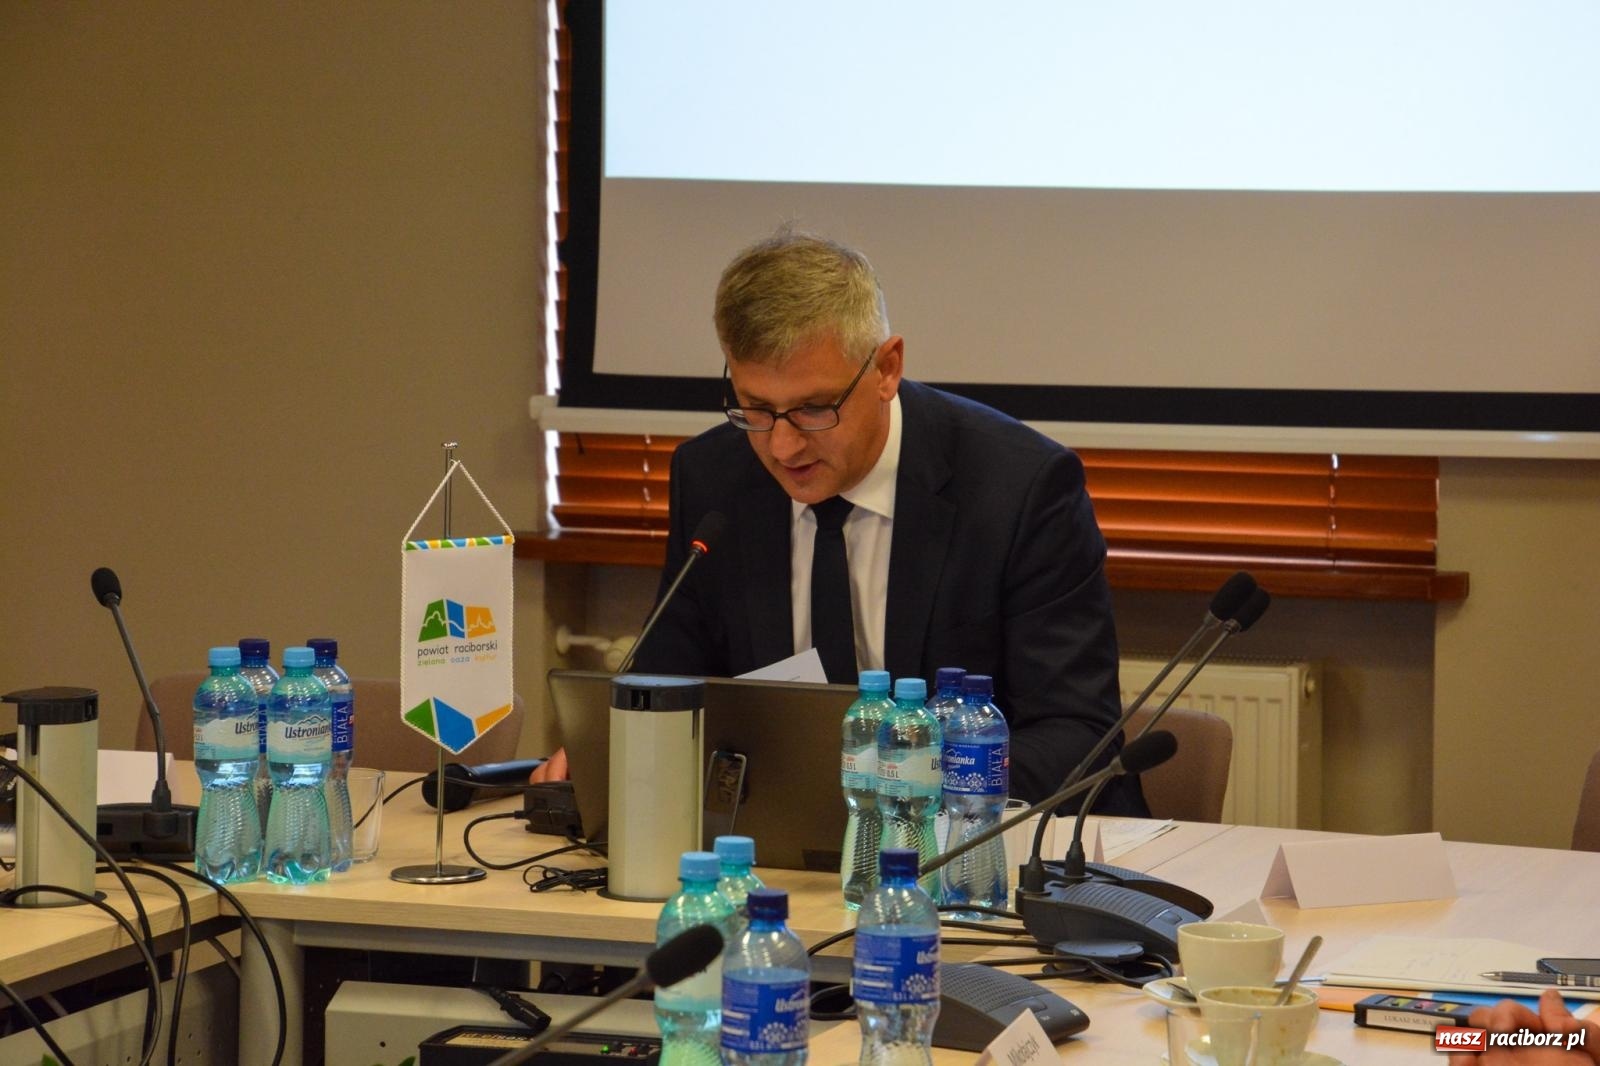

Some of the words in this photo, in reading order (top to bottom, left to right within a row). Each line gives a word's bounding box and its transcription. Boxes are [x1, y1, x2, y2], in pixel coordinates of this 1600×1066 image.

[417, 644, 449, 658] powiat
[454, 640, 498, 653] raciborski
[337, 705, 348, 744] BIAŁA
[991, 747, 1002, 786] BIAŁA
